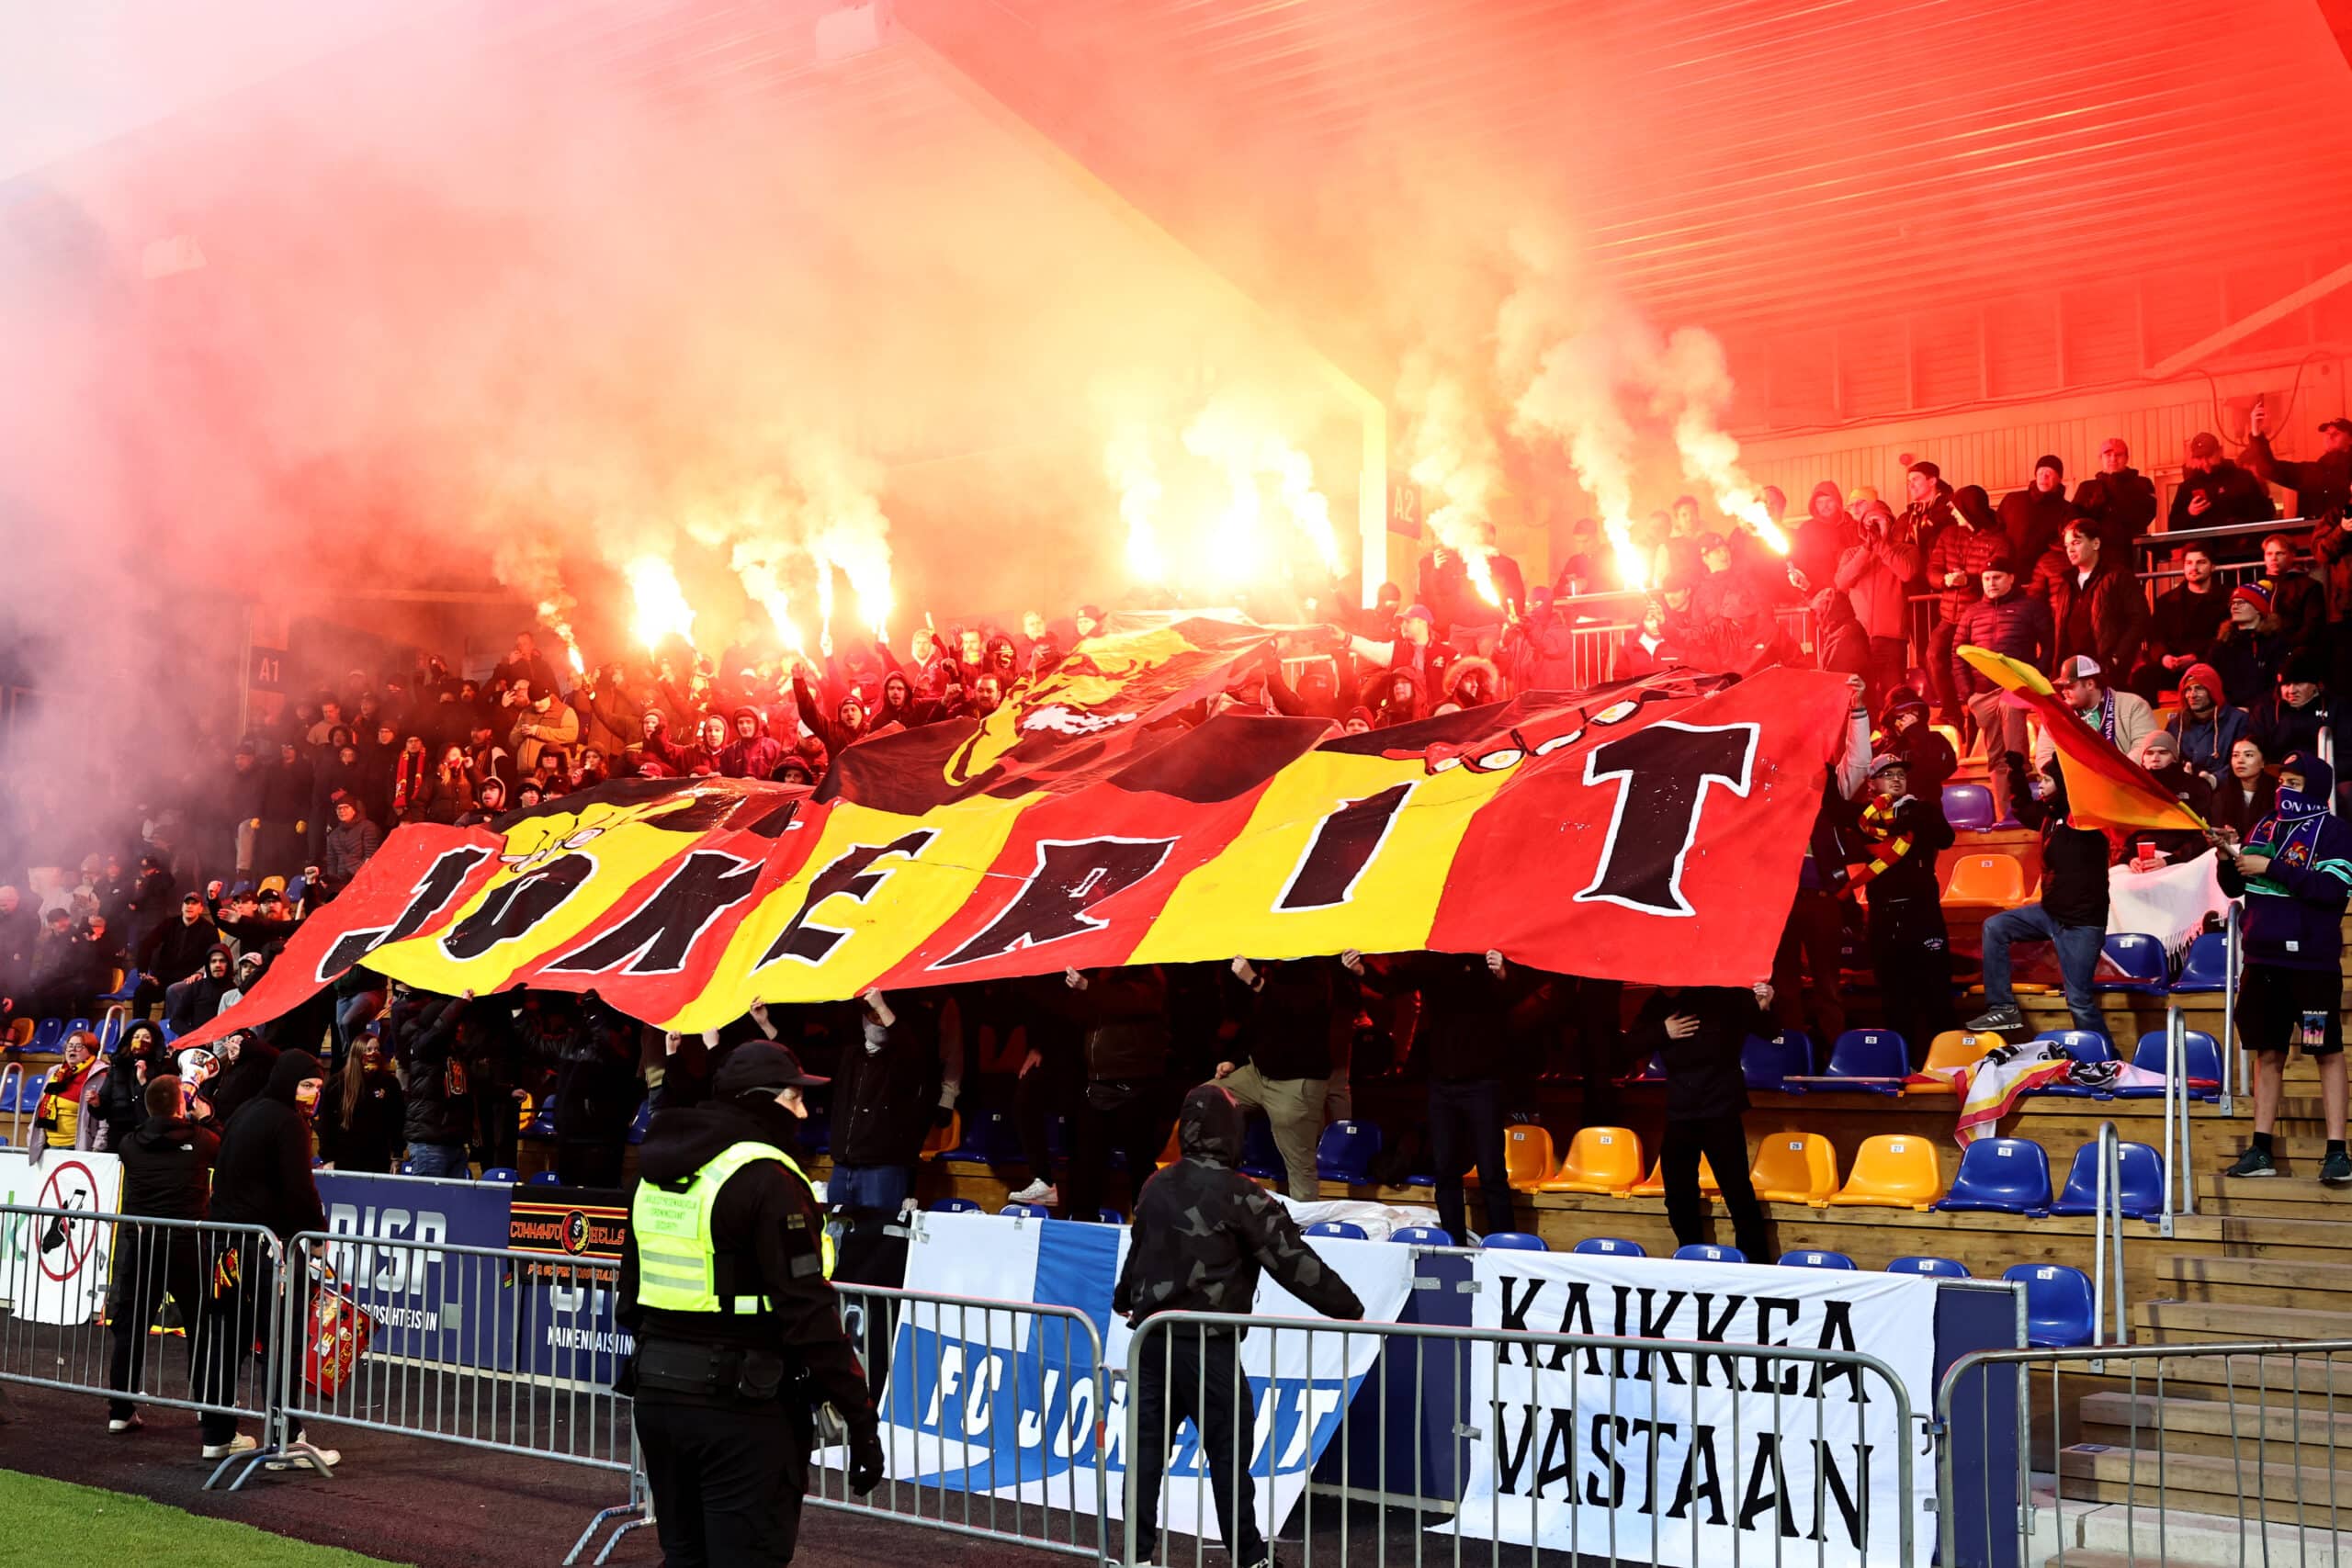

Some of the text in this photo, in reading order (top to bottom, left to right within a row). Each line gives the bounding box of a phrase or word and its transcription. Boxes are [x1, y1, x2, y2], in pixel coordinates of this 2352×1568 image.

[1394, 485, 1415, 523] A2
[259, 657, 279, 682] A1
[315, 721, 1759, 984] JOKERIT
[2281, 799, 2302, 812] ON
[303, 1203, 447, 1295] RISP
[1498, 1275, 1872, 1404] KAIKKEA
[923, 1344, 1341, 1470] FC JOKIT
[1488, 1399, 1874, 1552] VASTAAN
